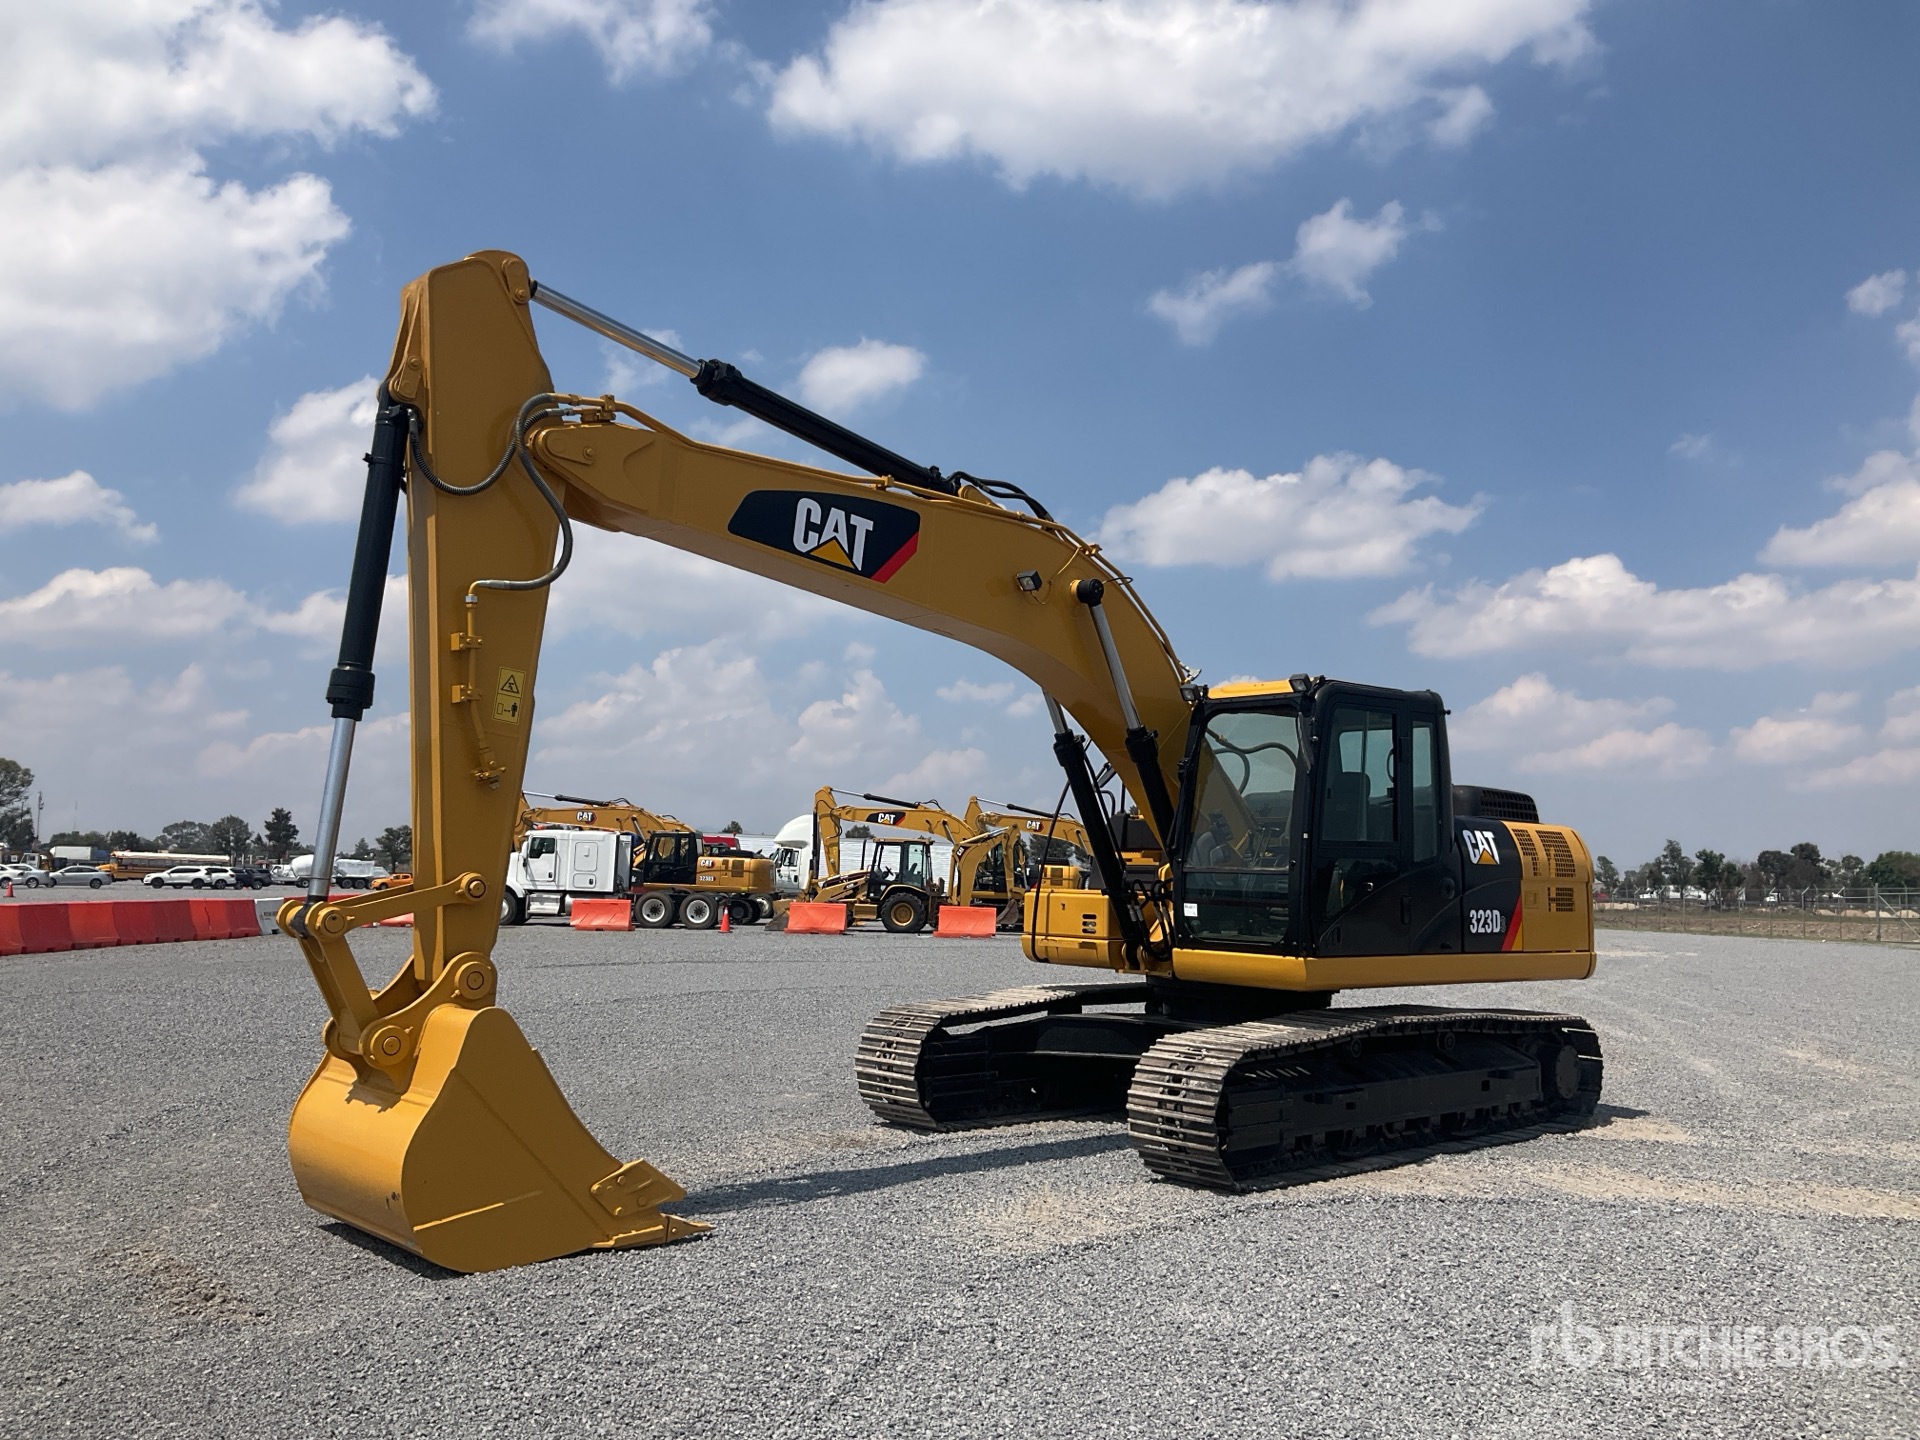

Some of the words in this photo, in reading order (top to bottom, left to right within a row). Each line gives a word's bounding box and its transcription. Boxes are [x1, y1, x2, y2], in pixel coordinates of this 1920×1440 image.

[793, 498, 873, 571] CAT
[577, 811, 593, 821] CAT
[878, 812, 895, 824] CAT
[1026, 820, 1040, 830] CAT
[1462, 829, 1500, 864] CAT
[700, 859, 713, 867] CAT
